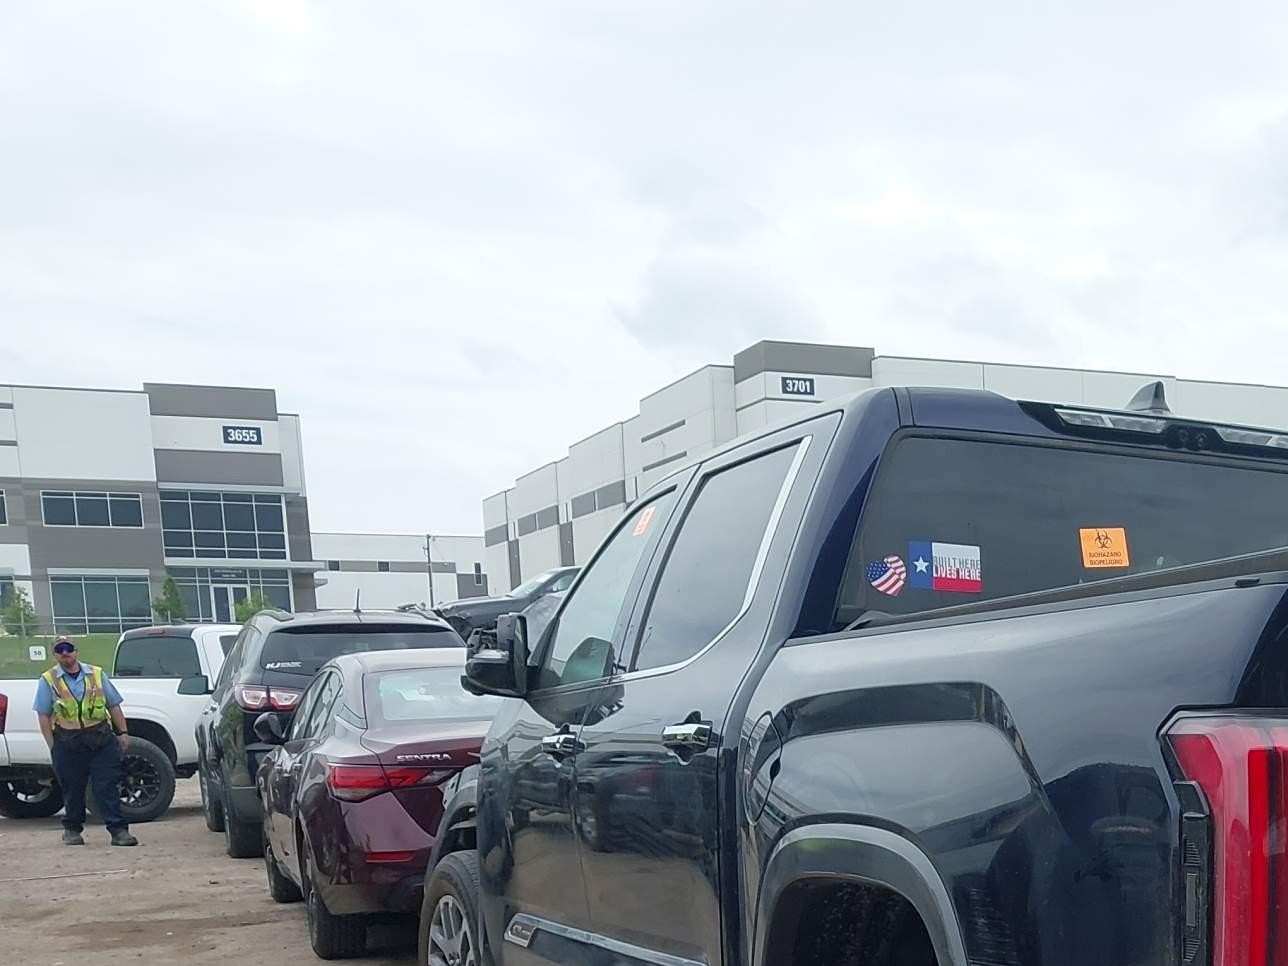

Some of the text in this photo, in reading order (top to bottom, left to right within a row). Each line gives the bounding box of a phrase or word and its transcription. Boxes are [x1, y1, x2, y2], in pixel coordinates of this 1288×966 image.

[786, 379, 811, 393] 3701
[227, 428, 258, 442] 3655
[958, 557, 981, 570] HERE
[933, 565, 982, 581] LIVES HERE
[396, 753, 453, 762] SENTRA
